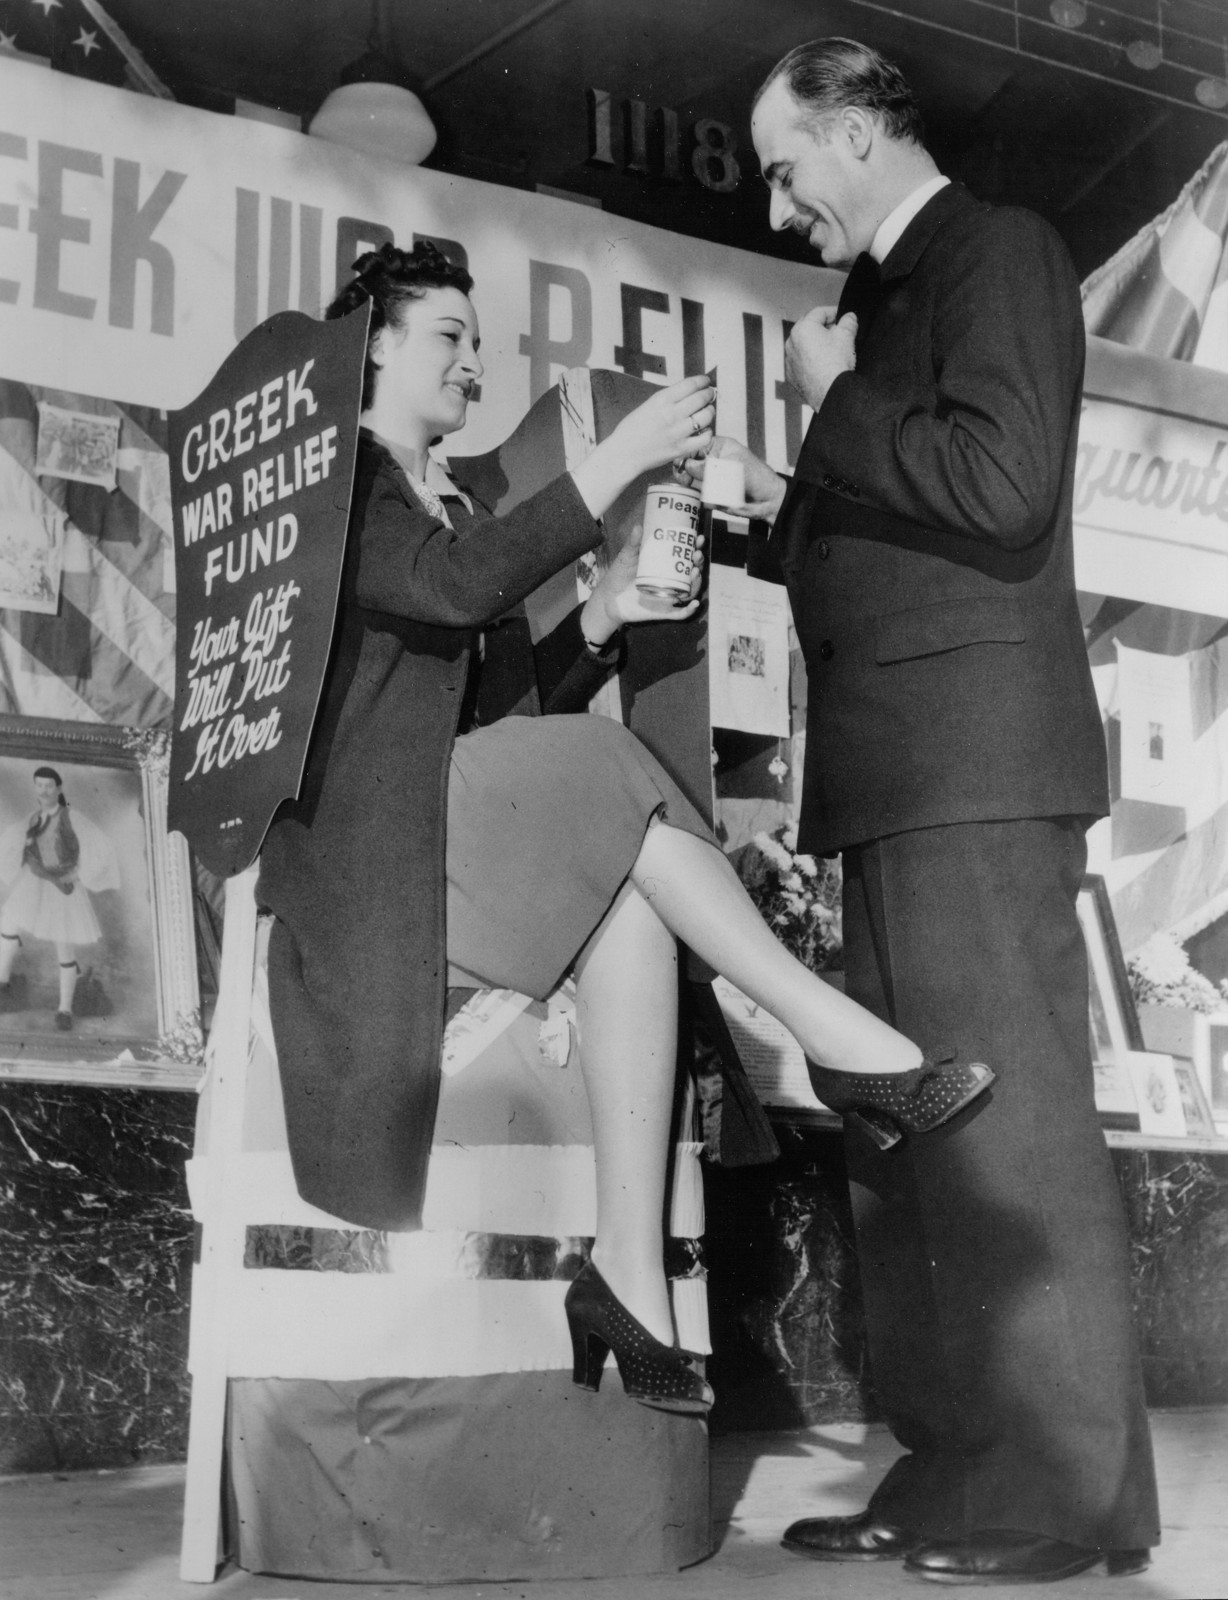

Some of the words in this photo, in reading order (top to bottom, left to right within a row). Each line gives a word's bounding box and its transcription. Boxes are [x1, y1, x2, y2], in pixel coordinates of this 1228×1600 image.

[587, 87, 741, 193] 1118
[182, 358, 318, 482] GREEK
[182, 483, 233, 547] WAR
[243, 425, 338, 517] RELIEF
[658, 496, 699, 515] Pleas
[204, 512, 299, 597] FUND
[187, 616, 240, 679] Your
[241, 579, 301, 664] Gift
[180, 662, 236, 732] Will
[233, 639, 291, 710] Put
[184, 718, 225, 782] It
[217, 706, 283, 769] Over
